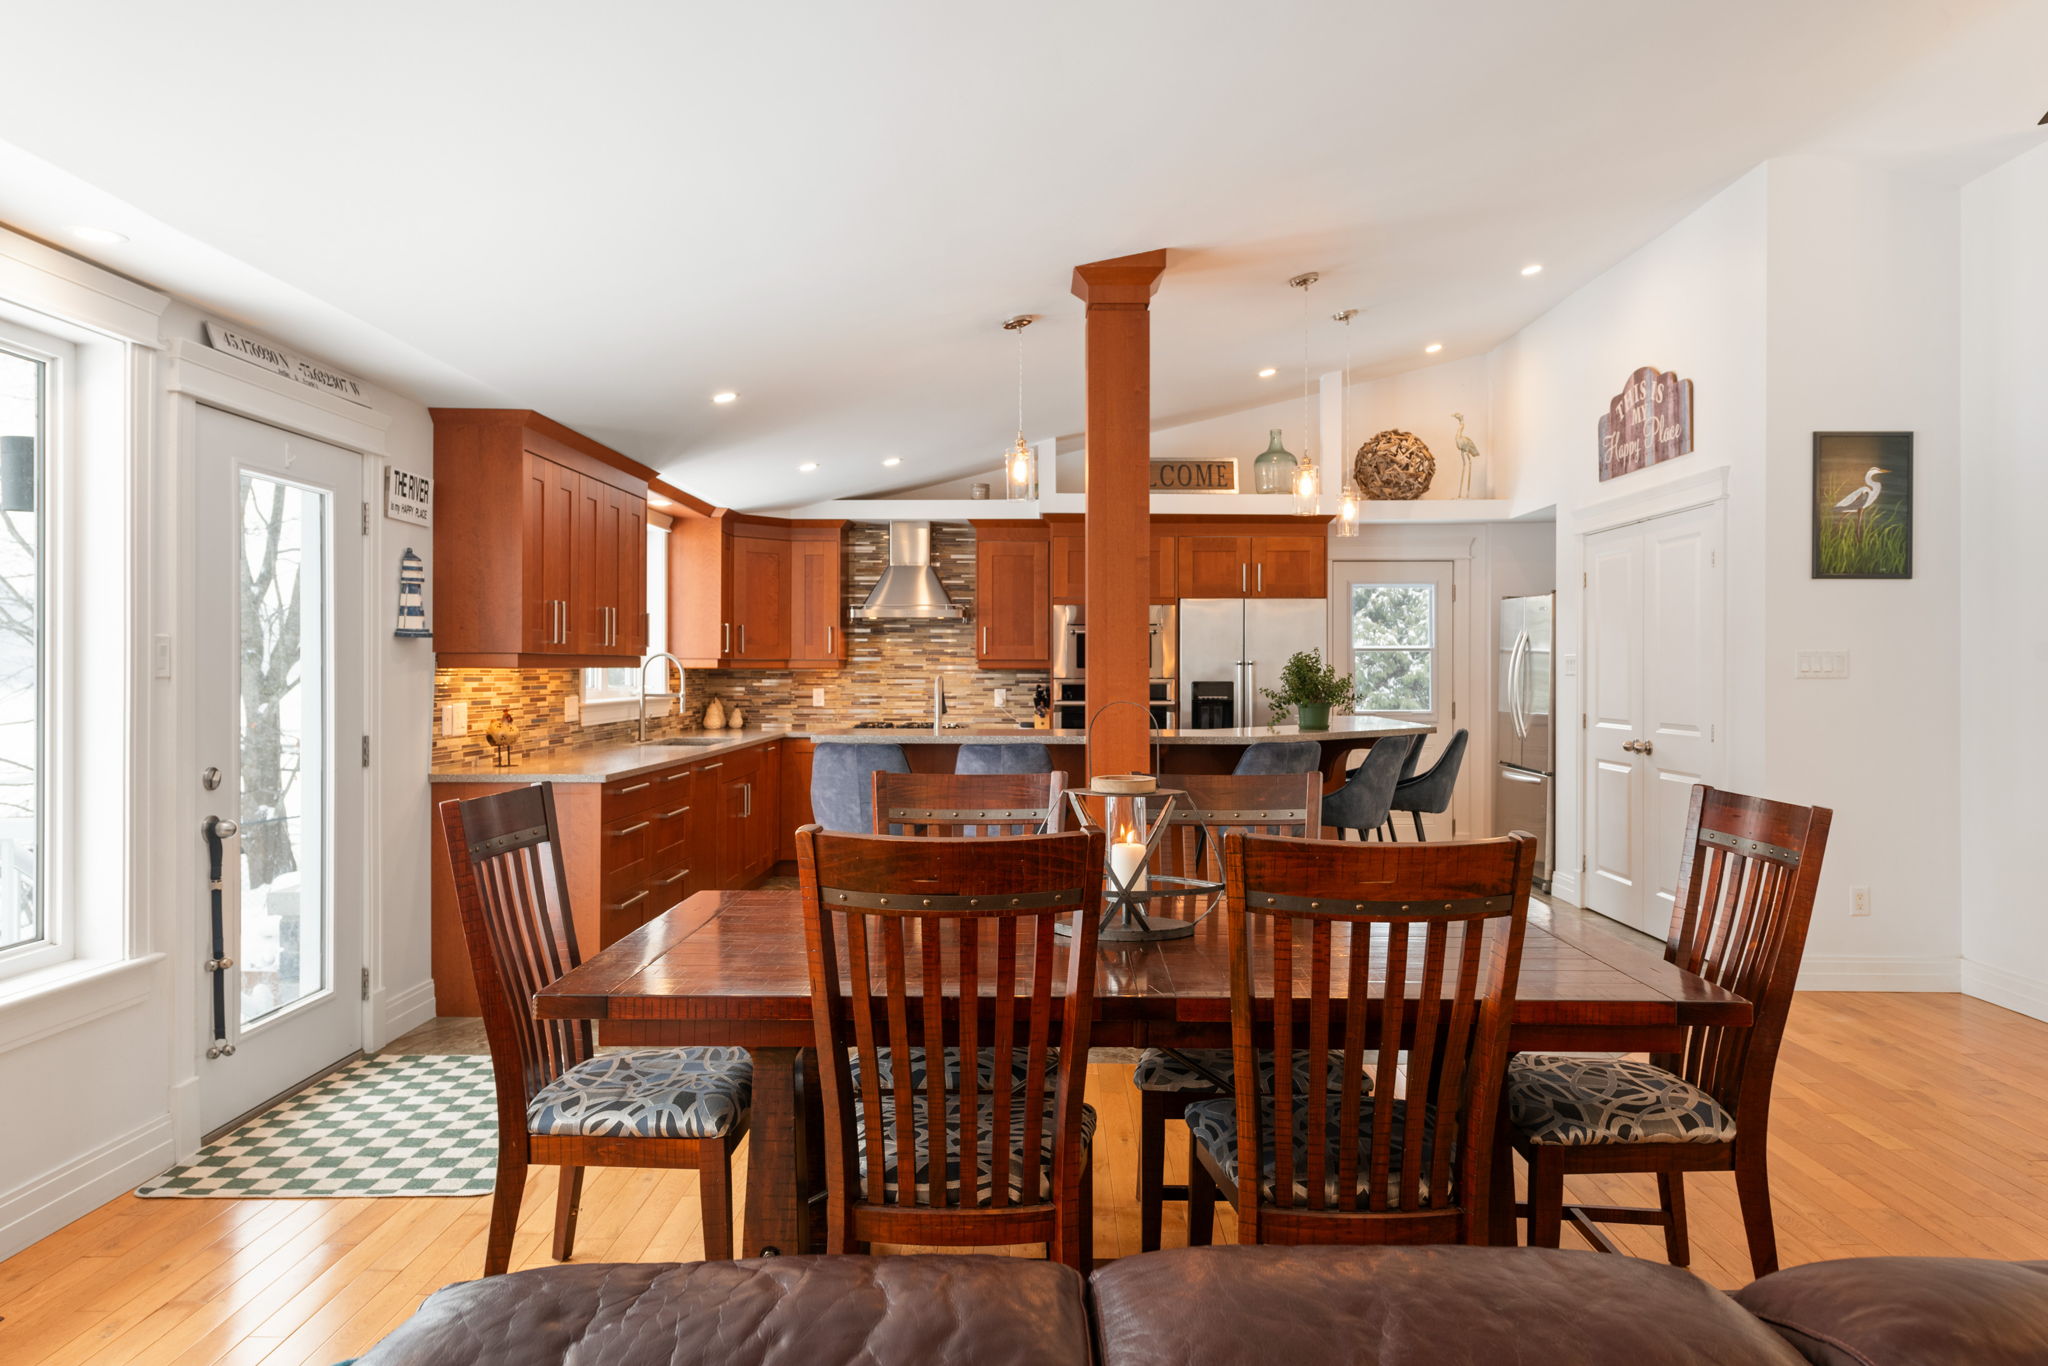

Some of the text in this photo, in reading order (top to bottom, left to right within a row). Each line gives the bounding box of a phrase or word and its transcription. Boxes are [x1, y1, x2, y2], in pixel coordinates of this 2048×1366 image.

[279, 351, 290, 368] N
[349, 380, 361, 396] W
[1615, 379, 1665, 422] THIS IS
[1631, 403, 1649, 426] MY
[1602, 414, 1682, 469] Happy Place
[394, 470, 429, 504] THE RIVER
[401, 504, 414, 516] HAPPY
[415, 507, 428, 520] PLACE
